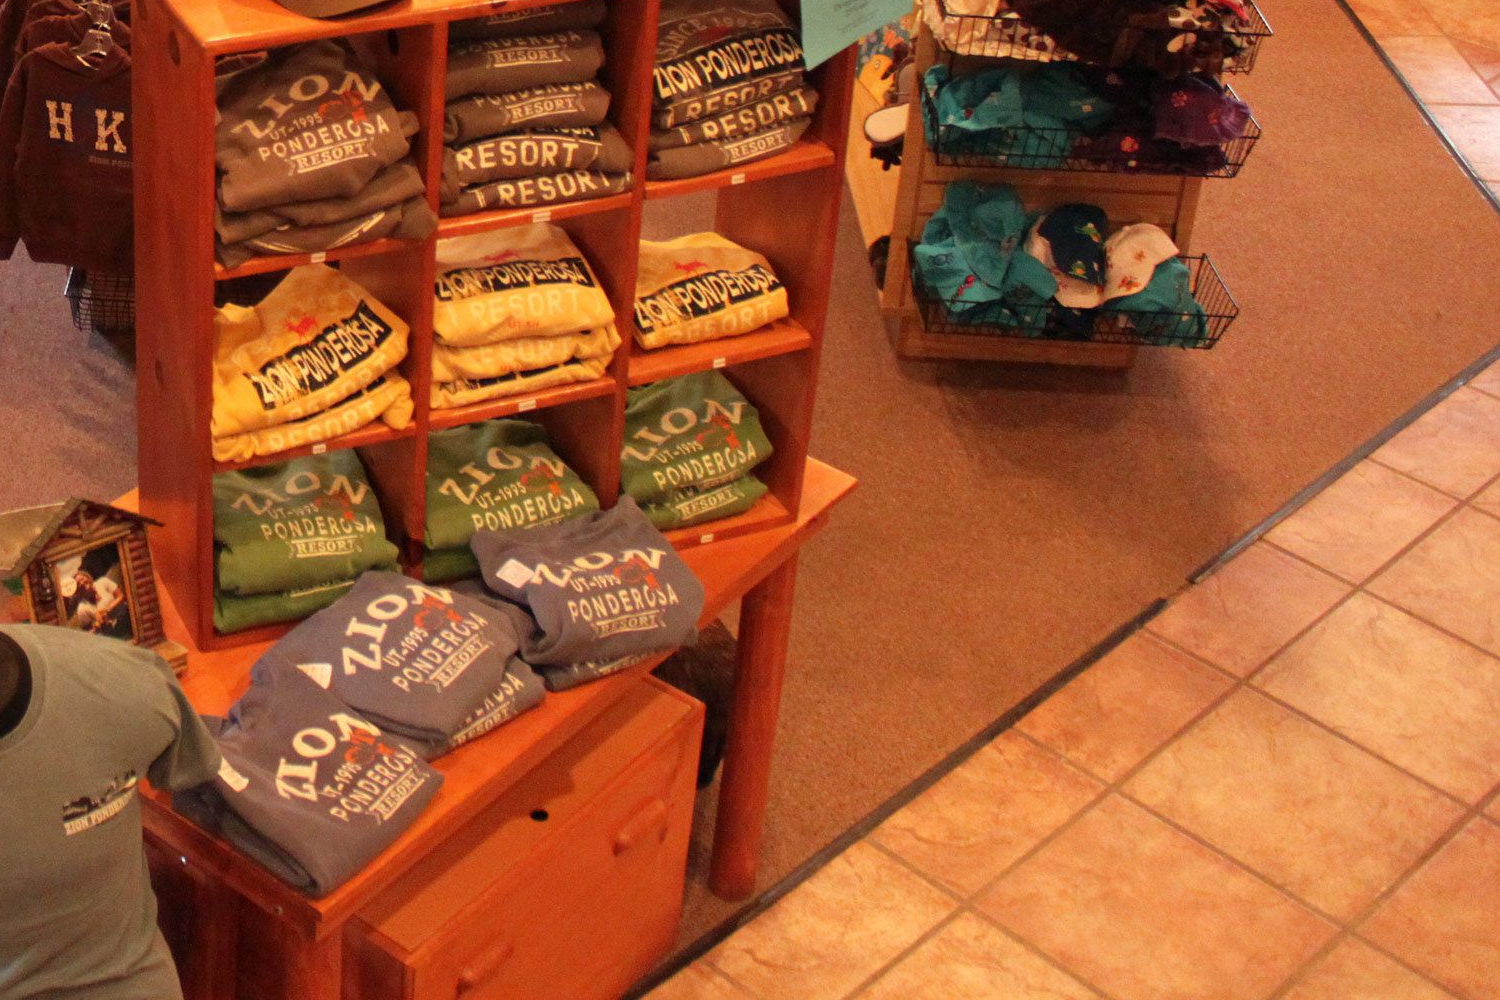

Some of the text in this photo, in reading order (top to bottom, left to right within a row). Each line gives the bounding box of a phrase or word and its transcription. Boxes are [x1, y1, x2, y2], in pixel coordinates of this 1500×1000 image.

[493, 48, 560, 64] RESORT
[653, 33, 804, 99] ZION PONDEROSA
[230, 71, 382, 139] ZION
[511, 99, 575, 119] RESORT
[258, 114, 390, 162] PONDEROSA
[297, 142, 366, 169] RESORT
[455, 140, 580, 171] RESORT
[730, 133, 785, 159] RESORT
[484, 262, 588, 292] PONDEROSA
[633, 267, 780, 329] ZION PONDEROSA
[291, 311, 385, 388] PONDEROSA
[621, 397, 747, 462] ZION
[438, 446, 566, 506] ZION
[652, 440, 757, 490] PONDEROSA
[230, 471, 370, 516] ZION
[470, 487, 585, 532] PONDEROSA
[681, 488, 734, 517] RESORT
[260, 515, 377, 541] PONDEROSA
[295, 539, 355, 555] RESORT
[567, 582, 679, 624] PONDEROSA
[599, 614, 657, 633] RESORT
[341, 584, 454, 676] ZION
[392, 611, 489, 693] PONDEROSA
[436, 639, 485, 683] RESORT
[377, 771, 420, 817] RESORT
